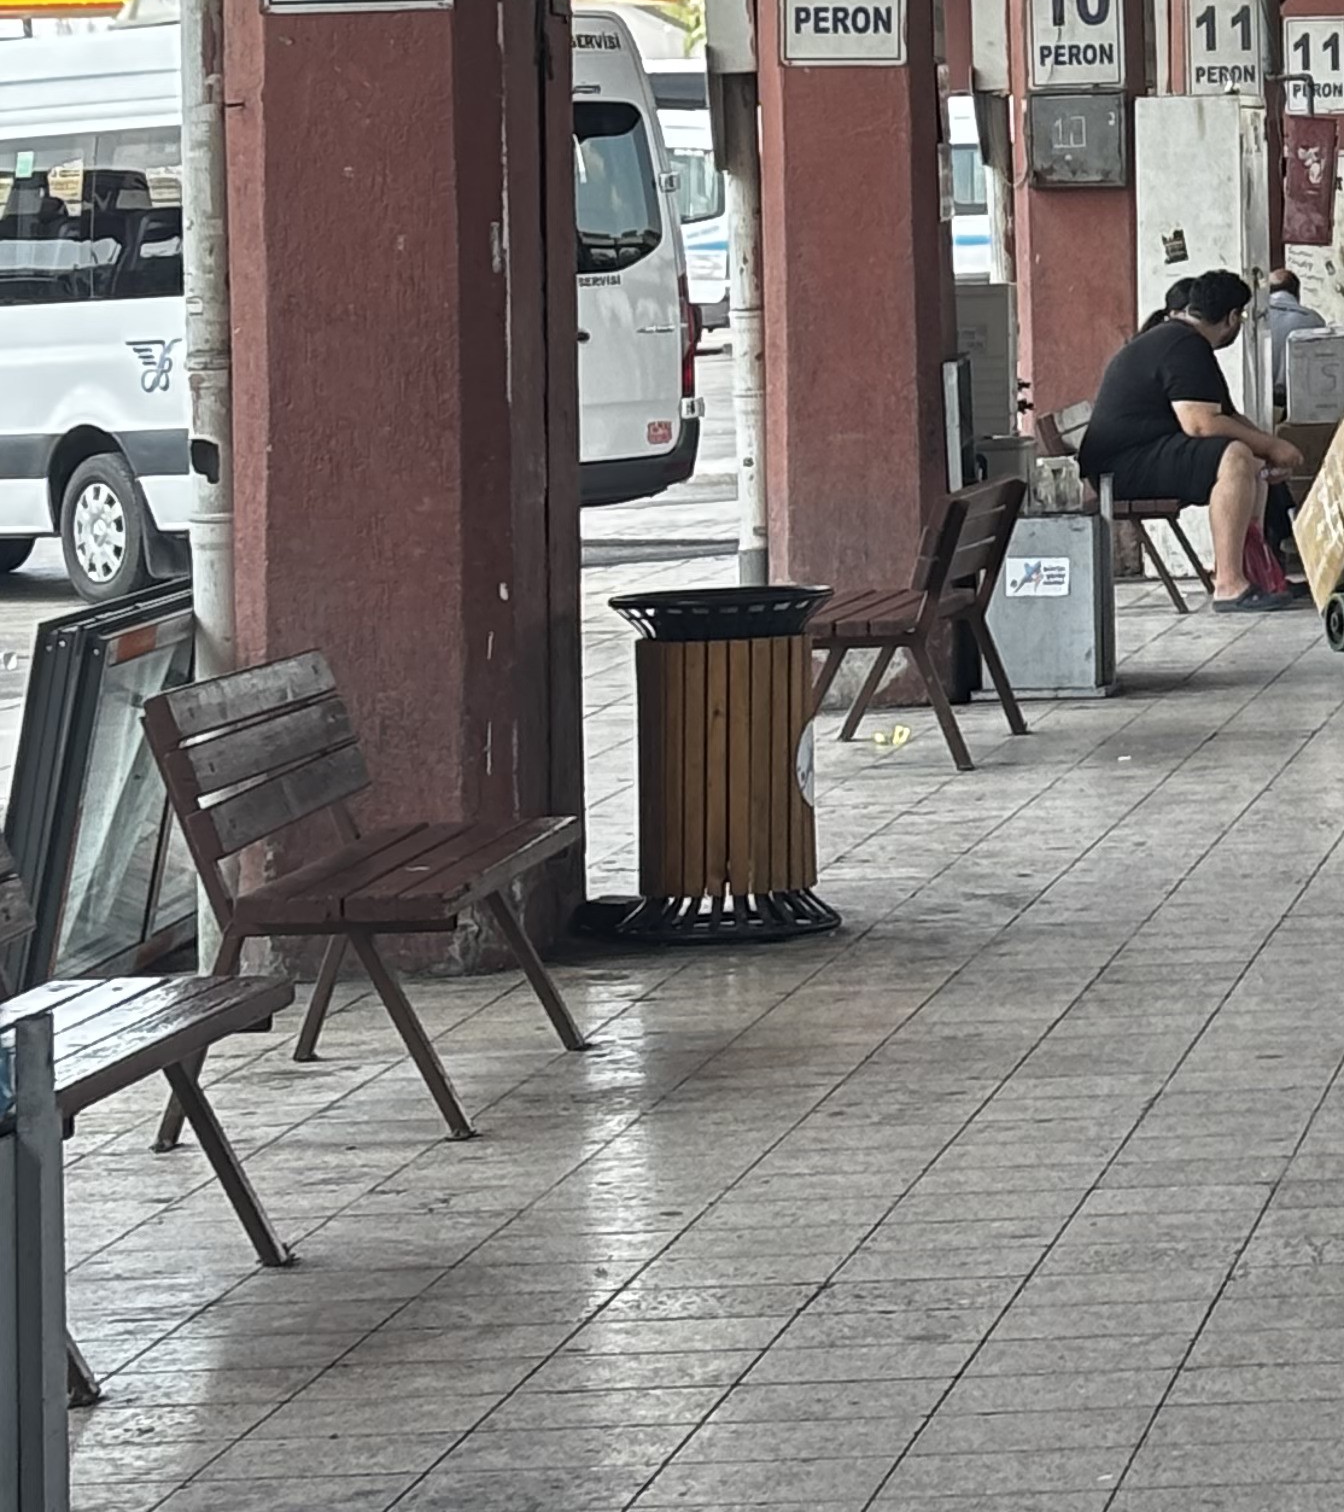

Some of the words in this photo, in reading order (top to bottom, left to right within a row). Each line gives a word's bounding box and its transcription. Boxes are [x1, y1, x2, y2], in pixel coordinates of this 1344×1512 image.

[794, 5, 893, 35] PERON
[1195, 4, 1252, 52] 11
[1039, 42, 1115, 67] PERON
[1292, 31, 1340, 71] 11
[1195, 64, 1257, 85] PERON
